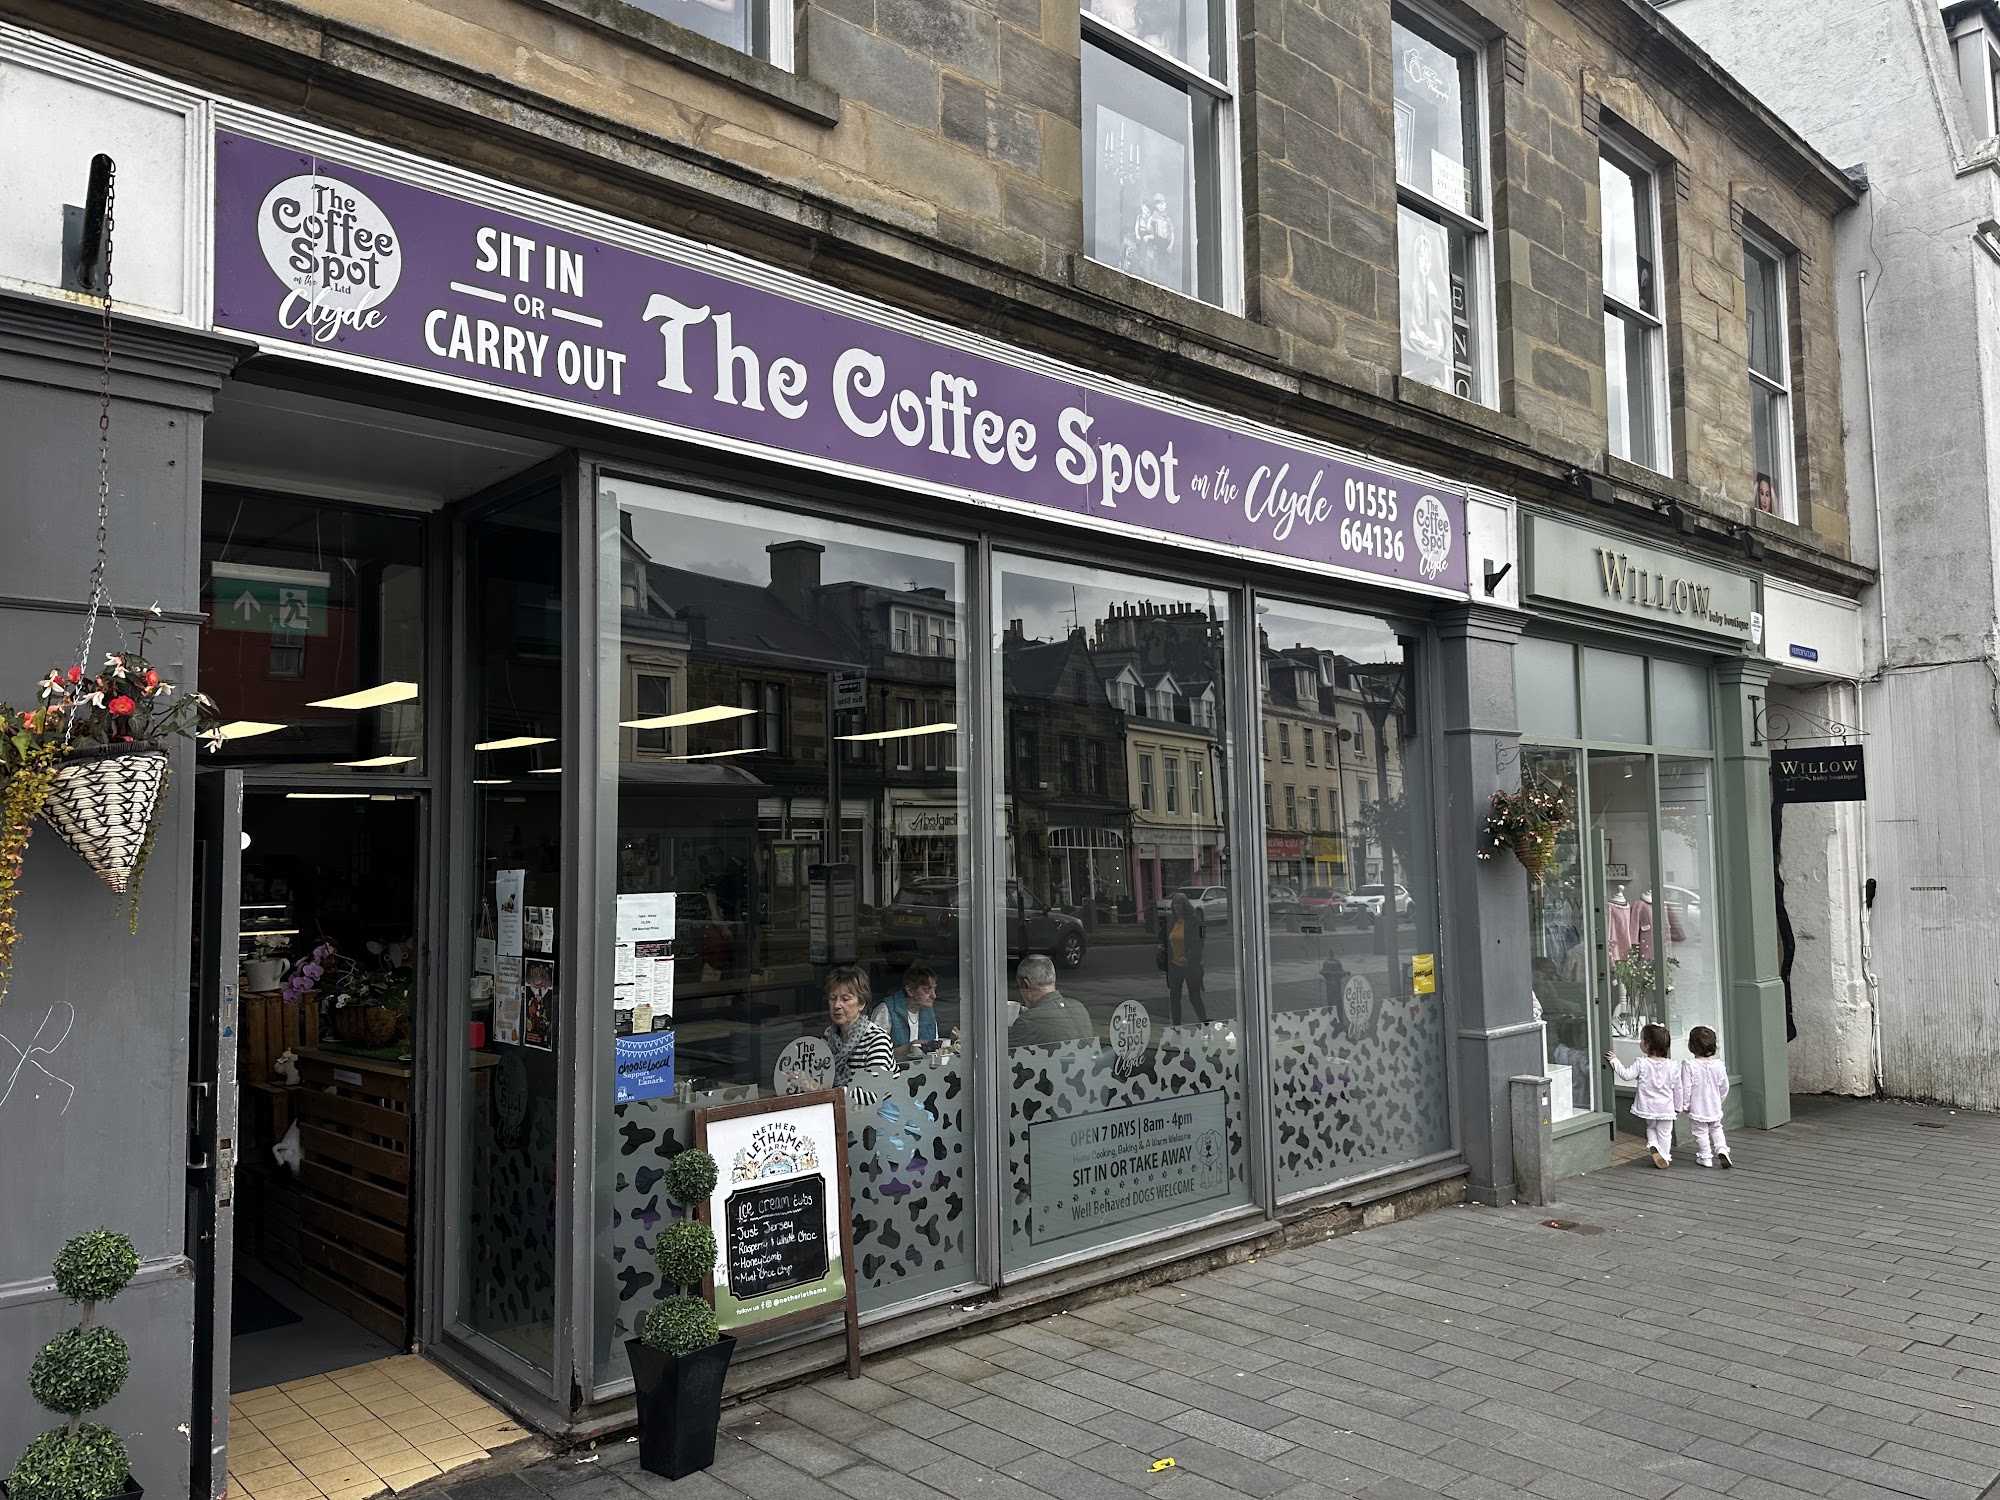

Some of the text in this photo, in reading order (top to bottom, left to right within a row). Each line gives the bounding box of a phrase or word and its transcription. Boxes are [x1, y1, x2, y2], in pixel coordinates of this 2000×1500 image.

[311, 184, 356, 215] The
[272, 197, 393, 258] Coffee
[289, 237, 381, 290] Spot
[475, 226, 584, 298] SIT IN
[334, 282, 351, 295] Ltd
[278, 286, 388, 343] Clyde
[513, 294, 546, 320] OR
[423, 308, 627, 396] CARRY OUT
[642, 293, 1332, 542] The Coffee Spot on the Clyde
[1343, 477, 1398, 522] 01555
[1426, 499, 1439, 515] The
[1416, 508, 1449, 536] Coffee
[1340, 517, 1405, 562] 664136
[1421, 528, 1446, 551] Spot
[1419, 550, 1449, 581] Clyde
[1599, 546, 1711, 619] WILLOW
[1708, 610, 1723, 627] baby
[1723, 614, 1749, 632] boutique
[1780, 760, 1858, 775] WILLOW
[1346, 986, 1371, 1005] Coffee
[1123, 1003, 1137, 1018] The
[1349, 999, 1369, 1019] Spot
[1112, 1013, 1148, 1035] Coffee
[796, 1041, 815, 1059] The
[1118, 1028, 1144, 1051] Spot
[618, 1060, 648, 1075] choose
[1115, 1046, 1146, 1078] Clyde
[623, 1071, 650, 1080] Support
[752, 1122, 797, 1140] NETHER
[1070, 1126, 1099, 1148] OPEN
[1101, 1125, 1108, 1142] 7
[1110, 1119, 1136, 1140] DAYS
[1143, 1117, 1164, 1133] 8am
[1171, 1112, 1193, 1130] 4pm
[746, 1131, 803, 1160] LETHAME
[763, 1143, 788, 1155] FARM
[1073, 1153, 1091, 1164] Home
[1117, 1142, 1138, 1155] Baking
[1138, 1140, 1144, 1150] &
[1145, 1139, 1151, 1148] A
[1151, 1136, 1168, 1147] Warm
[1168, 1132, 1192, 1144] Welcome
[1072, 1145, 1193, 1187] SIT IN OR TAKE AWAY
[758, 1196, 790, 1214] cream
[1071, 1178, 1195, 1221] Well Behaved DOGS WELCOME
[737, 1220, 794, 1240] Just Jersey
[797, 1230, 818, 1243] Choc
[773, 1287, 827, 1306] @netherlethame
